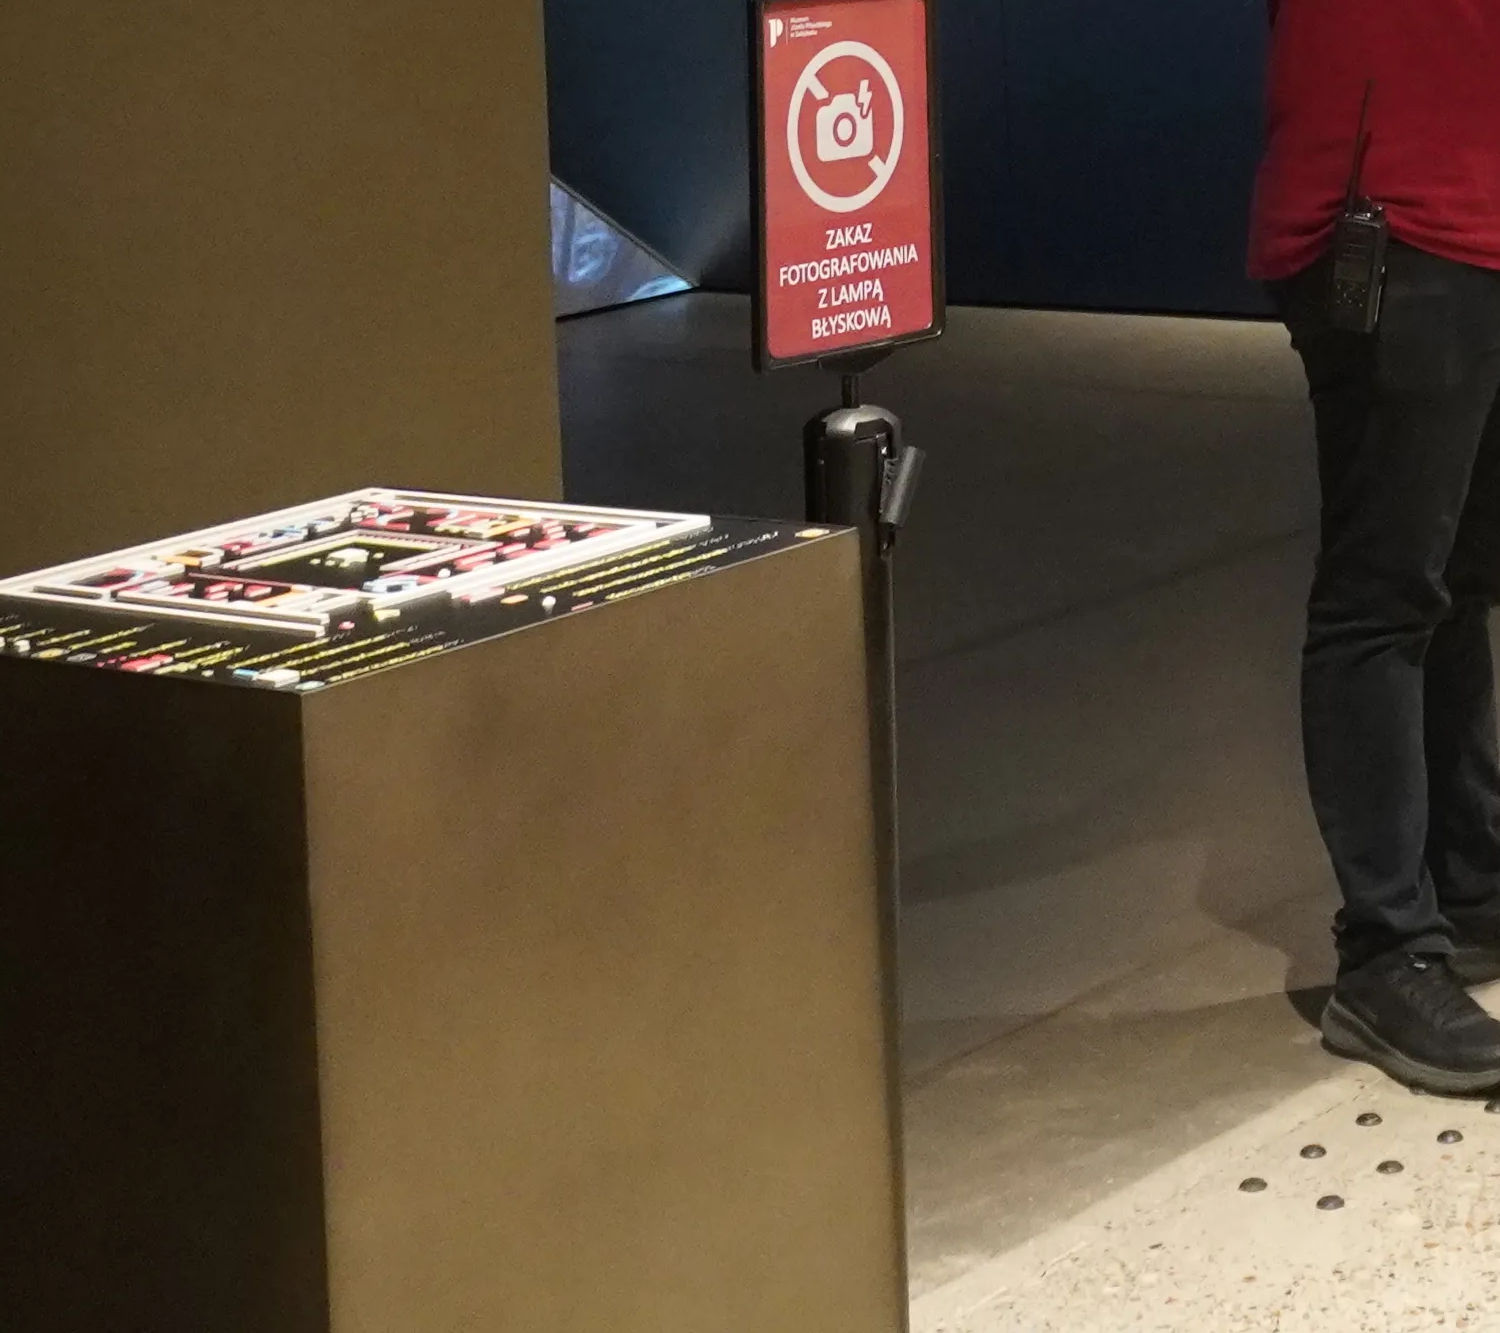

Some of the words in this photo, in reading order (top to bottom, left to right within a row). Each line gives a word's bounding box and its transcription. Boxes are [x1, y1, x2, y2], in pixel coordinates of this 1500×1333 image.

[825, 223, 872, 250] ZAKAZ
[779, 243, 918, 287] FOTOGRAFOWANIA
[818, 287, 828, 309] Z
[831, 278, 884, 307] LAMPĄ
[812, 304, 891, 339] BŁYSKOWĄ
